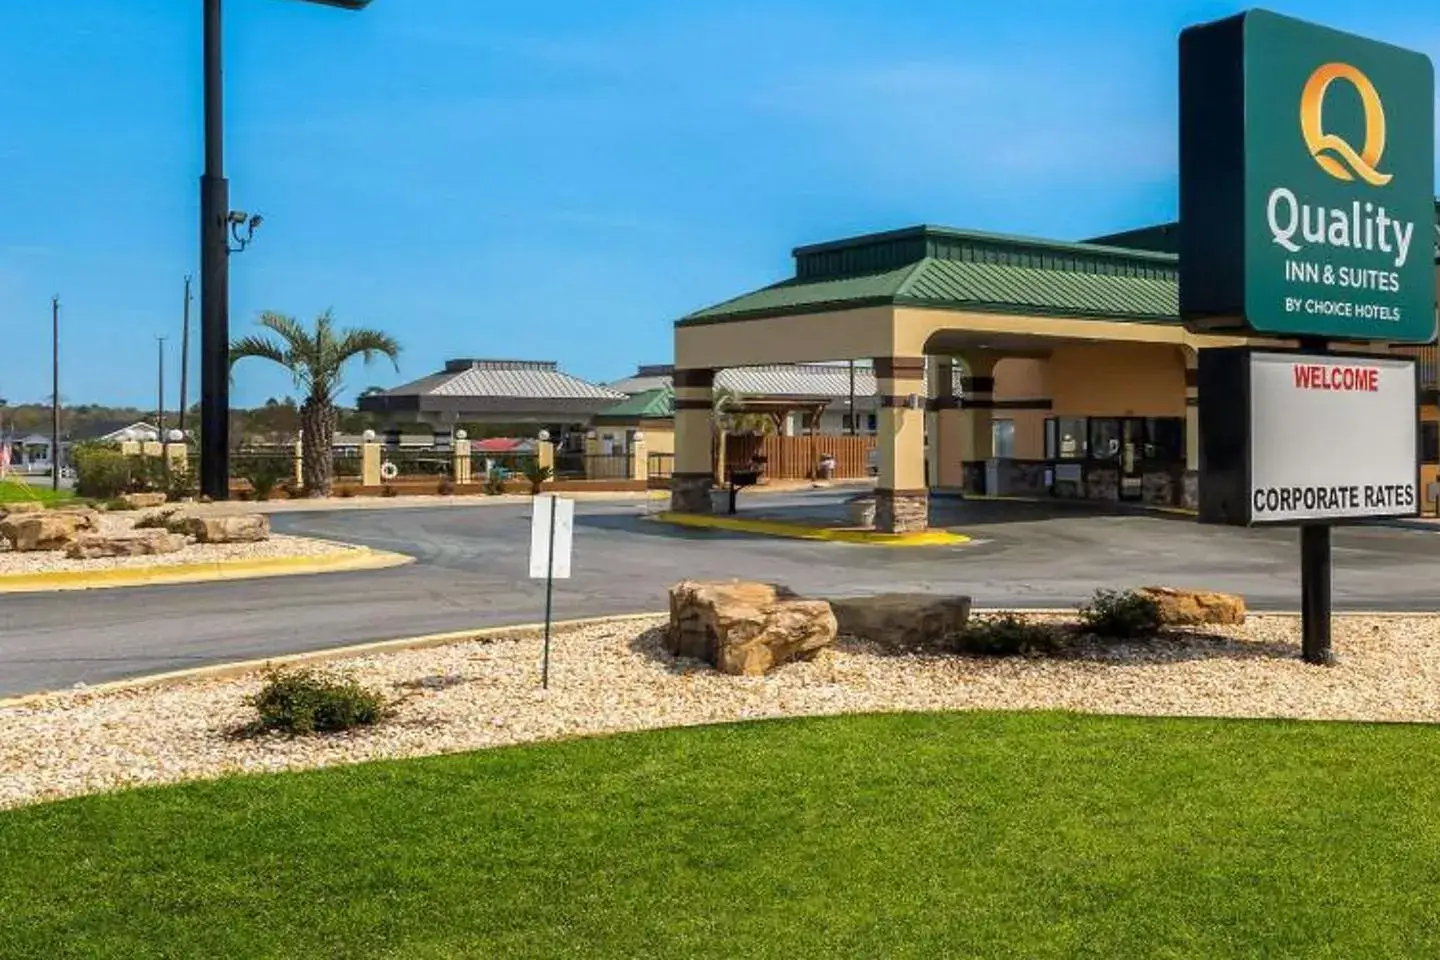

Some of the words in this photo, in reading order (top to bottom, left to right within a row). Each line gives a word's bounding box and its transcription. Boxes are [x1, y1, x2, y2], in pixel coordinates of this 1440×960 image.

[1266, 187, 1414, 267] Quality
[1285, 260, 1319, 284] INN
[1322, 264, 1336, 285] &
[1339, 266, 1400, 292] SUITES
[1285, 297, 1302, 312] BY
[1304, 299, 1353, 317] CHOICE
[1354, 303, 1401, 321] HOTELS
[1293, 364, 1379, 391] WELCOME
[1253, 486, 1360, 511] CORPORATE
[1364, 484, 1415, 507] RATES
